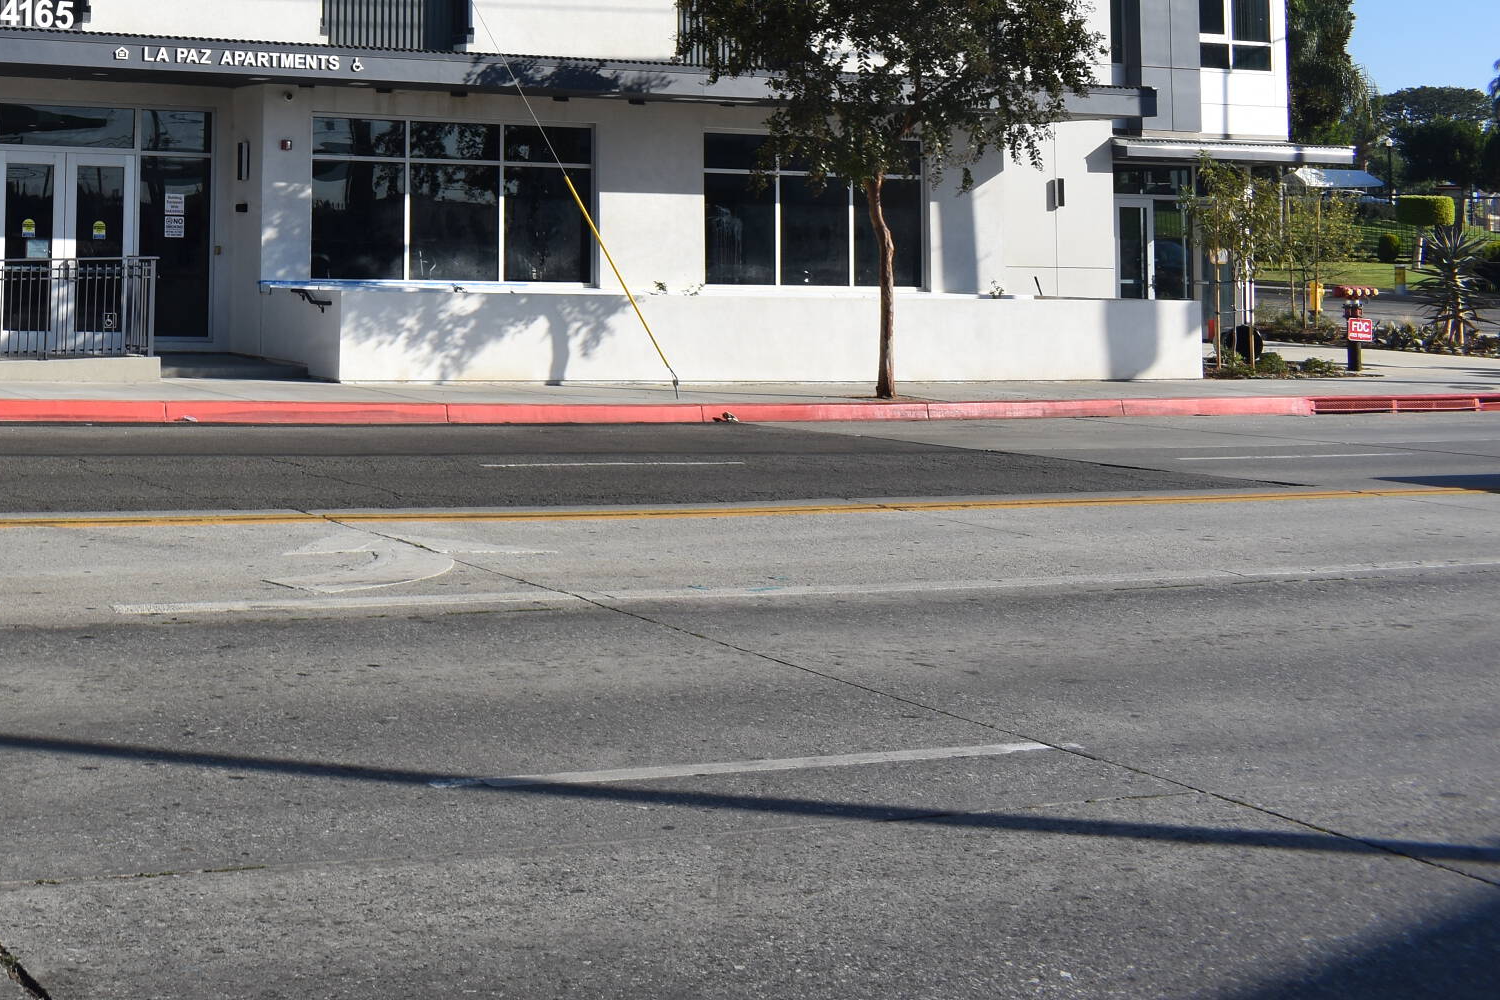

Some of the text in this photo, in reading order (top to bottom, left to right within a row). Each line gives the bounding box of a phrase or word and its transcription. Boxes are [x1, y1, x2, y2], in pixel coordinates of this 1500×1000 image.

[143, 46, 340, 70] LA PAZ APARTMENTS
[173, 217, 184, 225] NO
[1351, 321, 1370, 332] FDC
